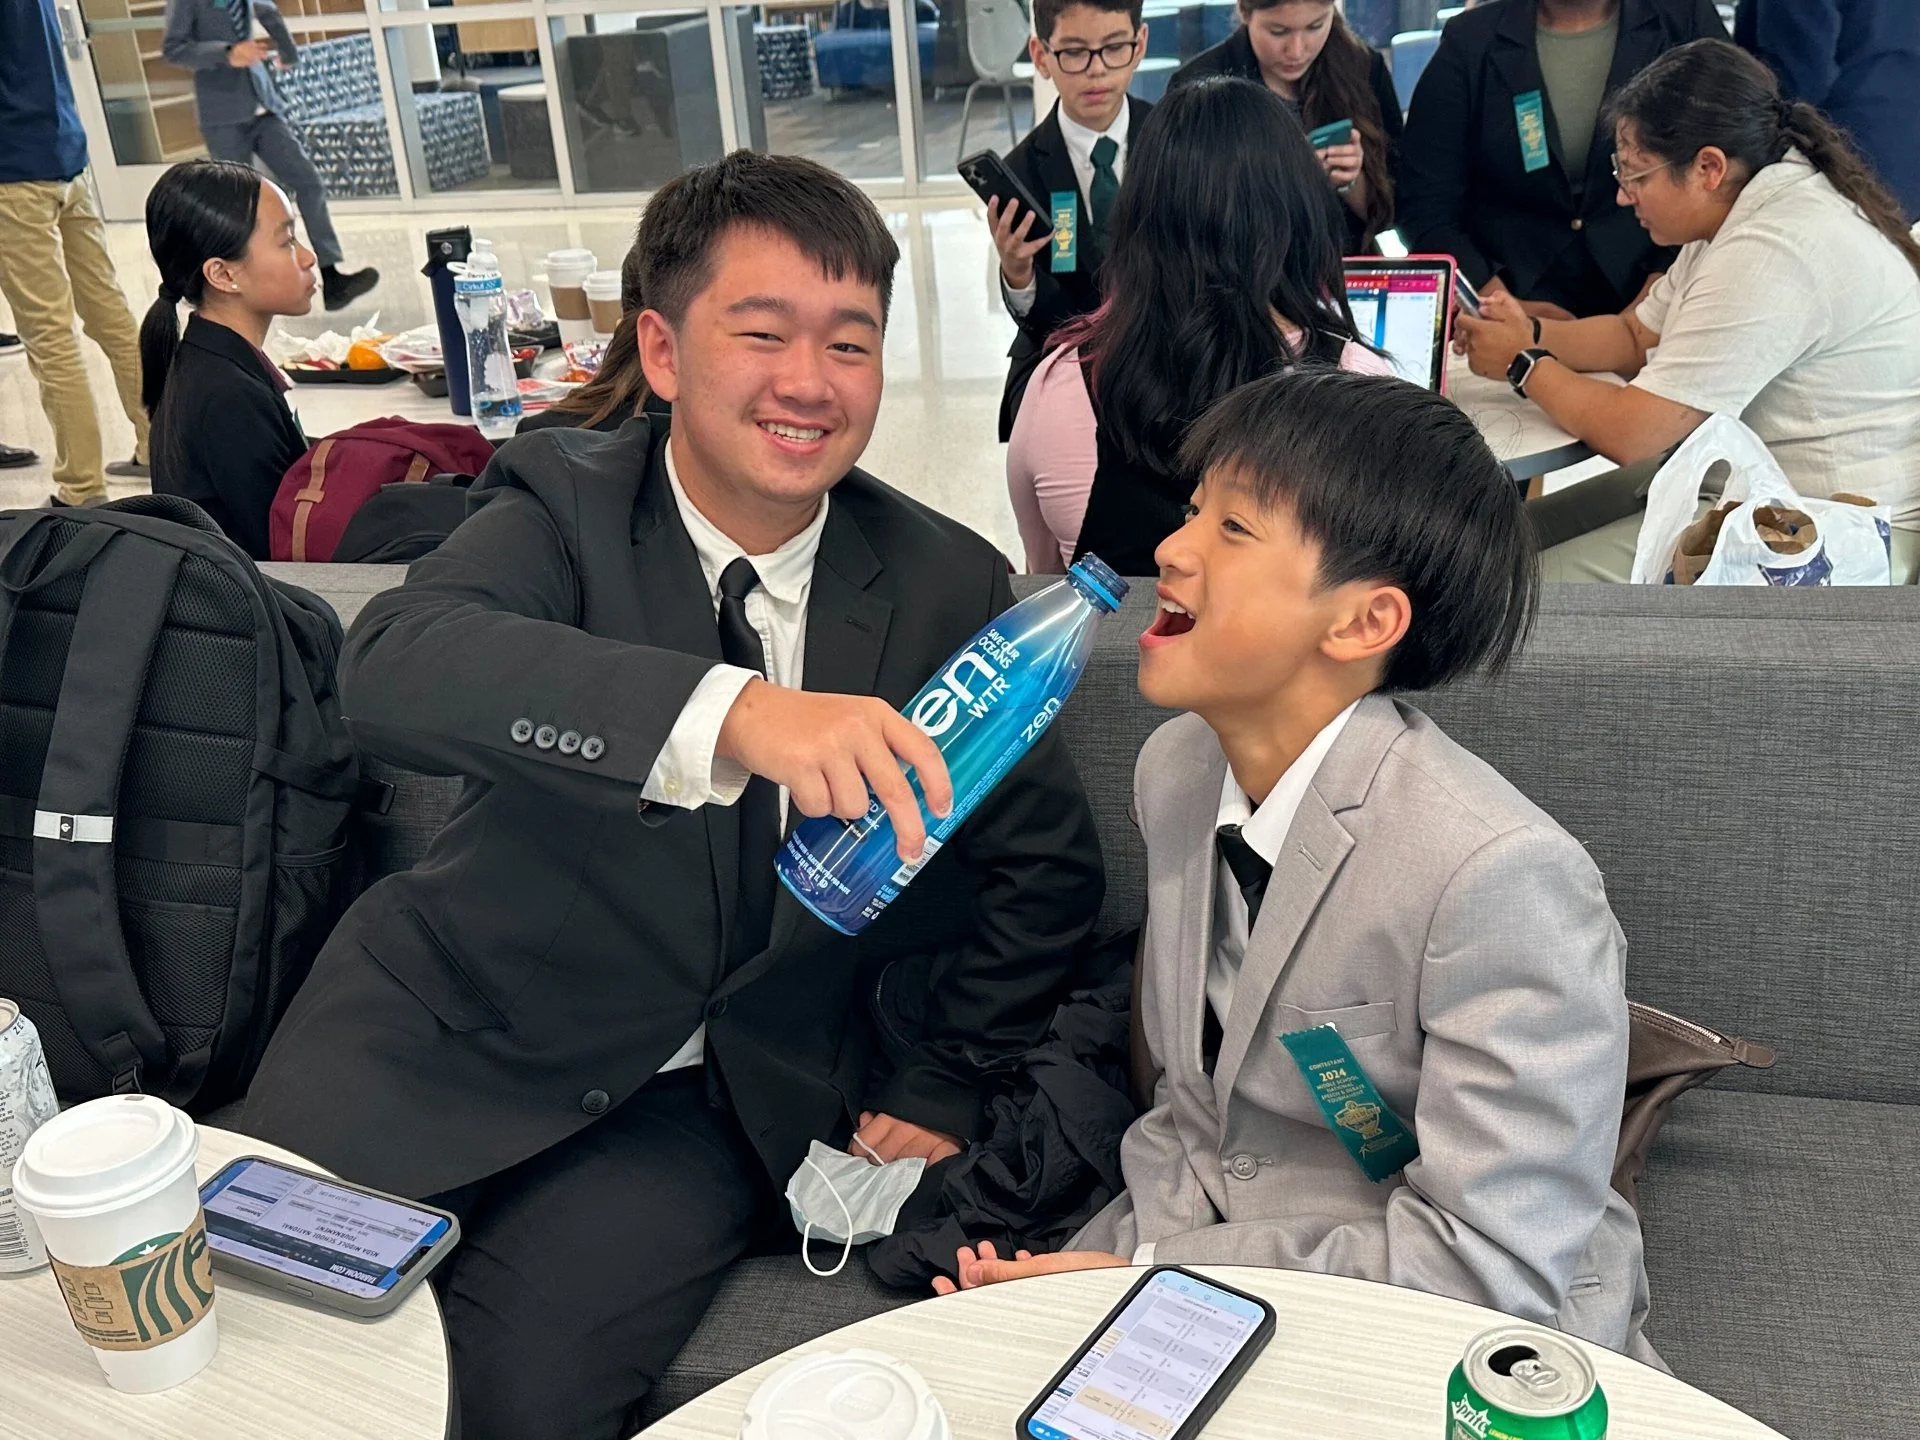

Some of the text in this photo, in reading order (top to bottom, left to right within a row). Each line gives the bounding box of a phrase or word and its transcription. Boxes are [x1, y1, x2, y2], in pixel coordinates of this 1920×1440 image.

[978, 636, 1012, 669] OCEANS
[987, 628, 1020, 660] SAVE OUR
[911, 652, 998, 738] en
[967, 675, 1012, 719] WTR
[1020, 697, 1061, 743] zen
[1308, 1057, 1345, 1070] CONTESTANT
[1319, 1068, 1347, 1082] 2024
[282, 1222, 312, 1236] NATIONAL
[316, 1225, 358, 1241] TOURNAMENT
[313, 1232, 337, 1245] SCHOOL
[337, 1241, 362, 1252] MIDDLE
[362, 1247, 380, 1258] NSDA
[329, 1263, 377, 1284] TABROOM.COM
[1455, 1397, 1488, 1432] Sprite
